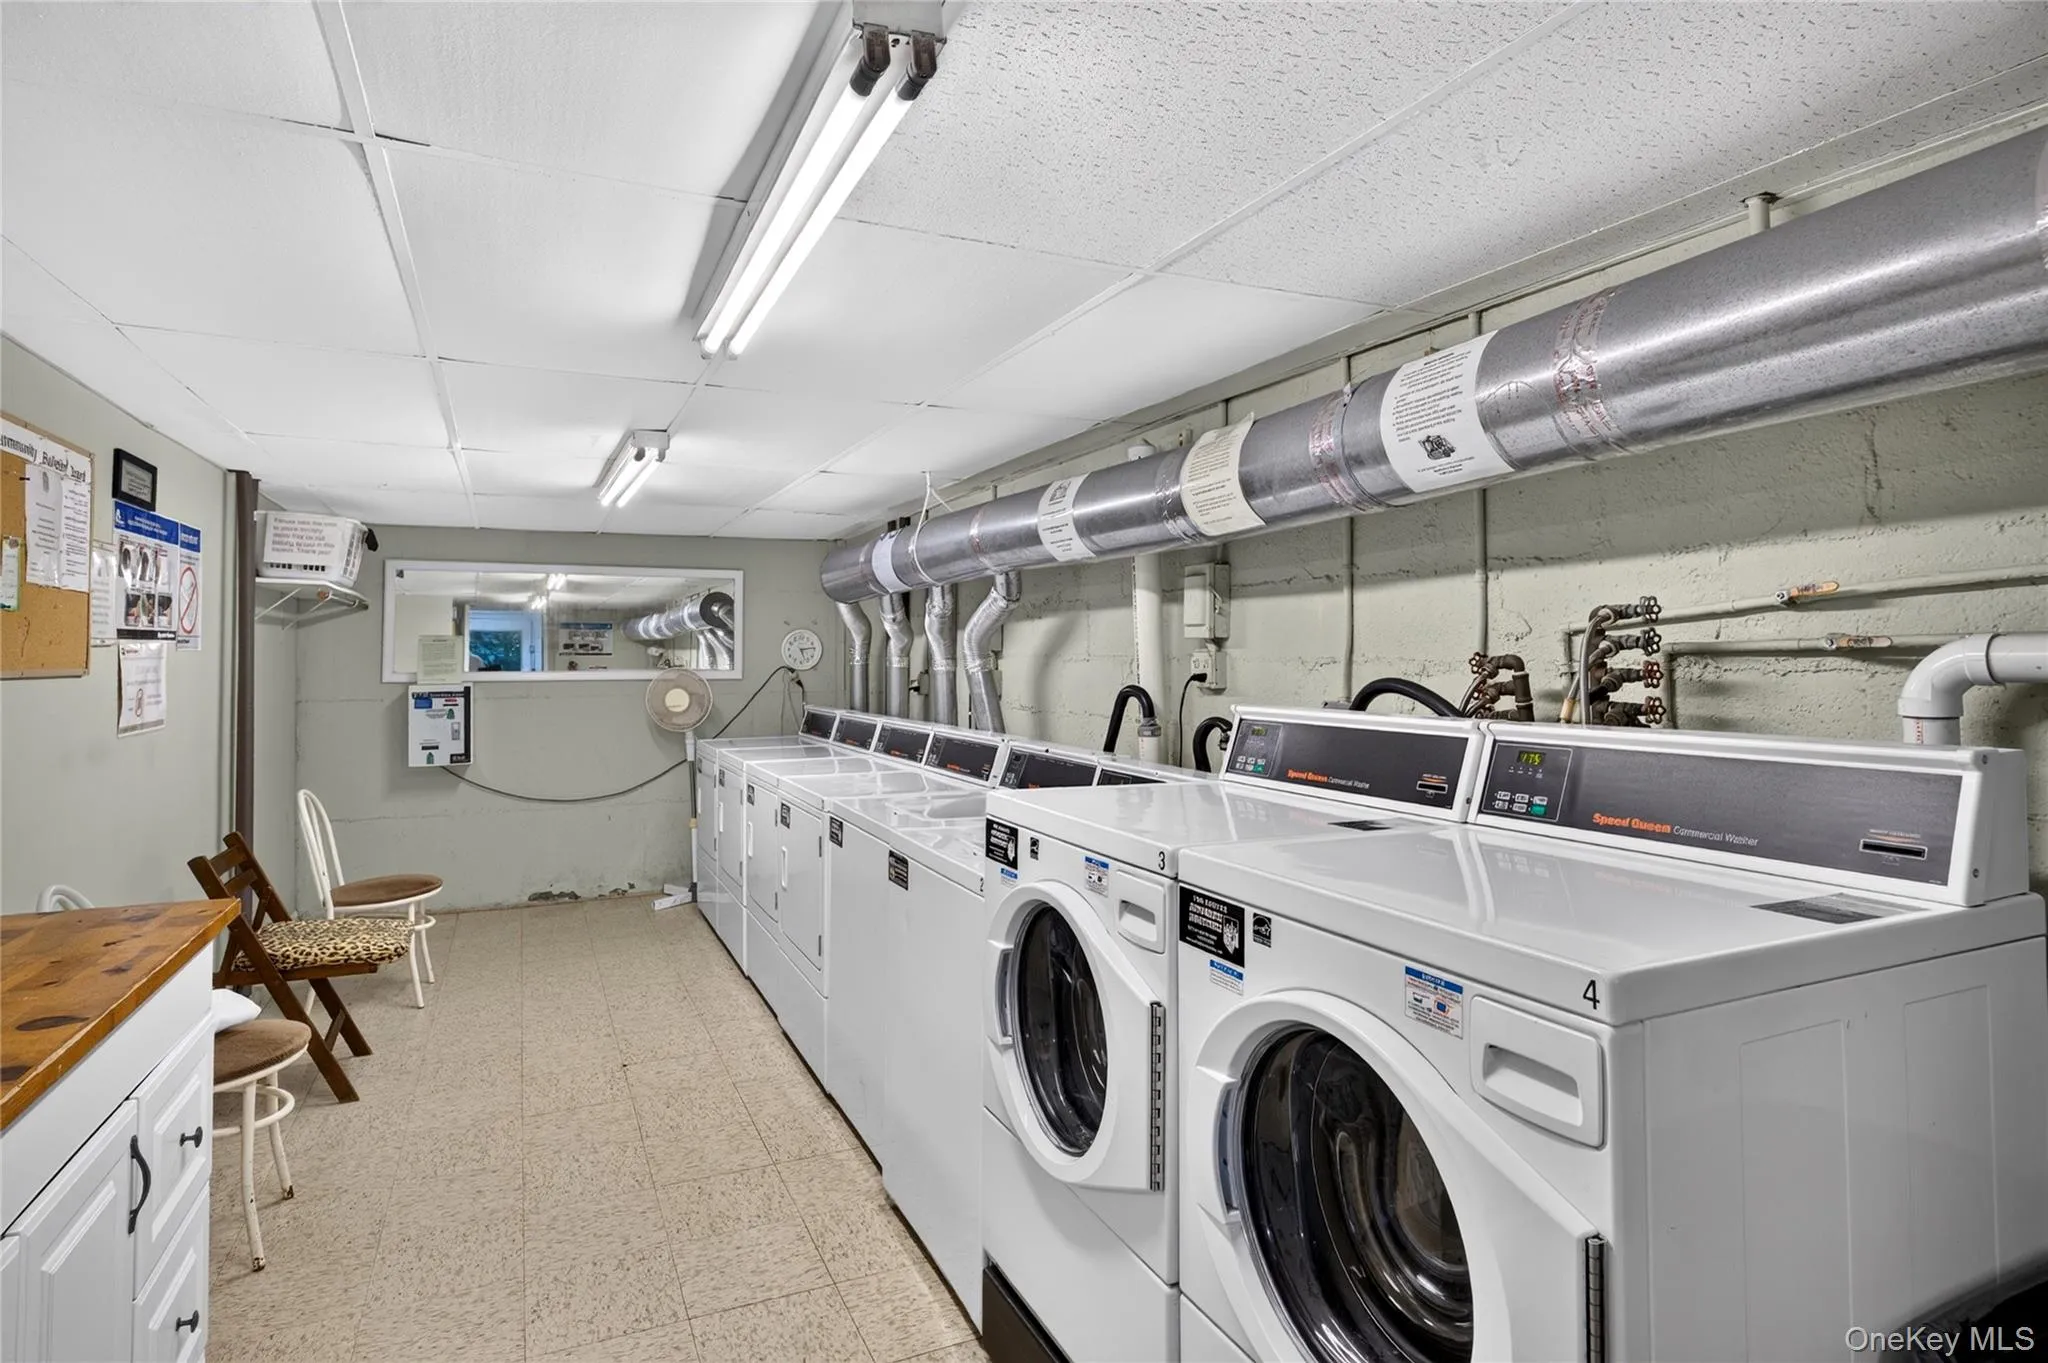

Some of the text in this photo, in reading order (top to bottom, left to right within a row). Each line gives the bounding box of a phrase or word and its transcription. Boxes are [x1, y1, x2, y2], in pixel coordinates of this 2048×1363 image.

[1592, 812, 1758, 847] Speed Queen Commercial Washer
[1158, 850, 1166, 871] 3
[1582, 979, 1601, 1010] 4
